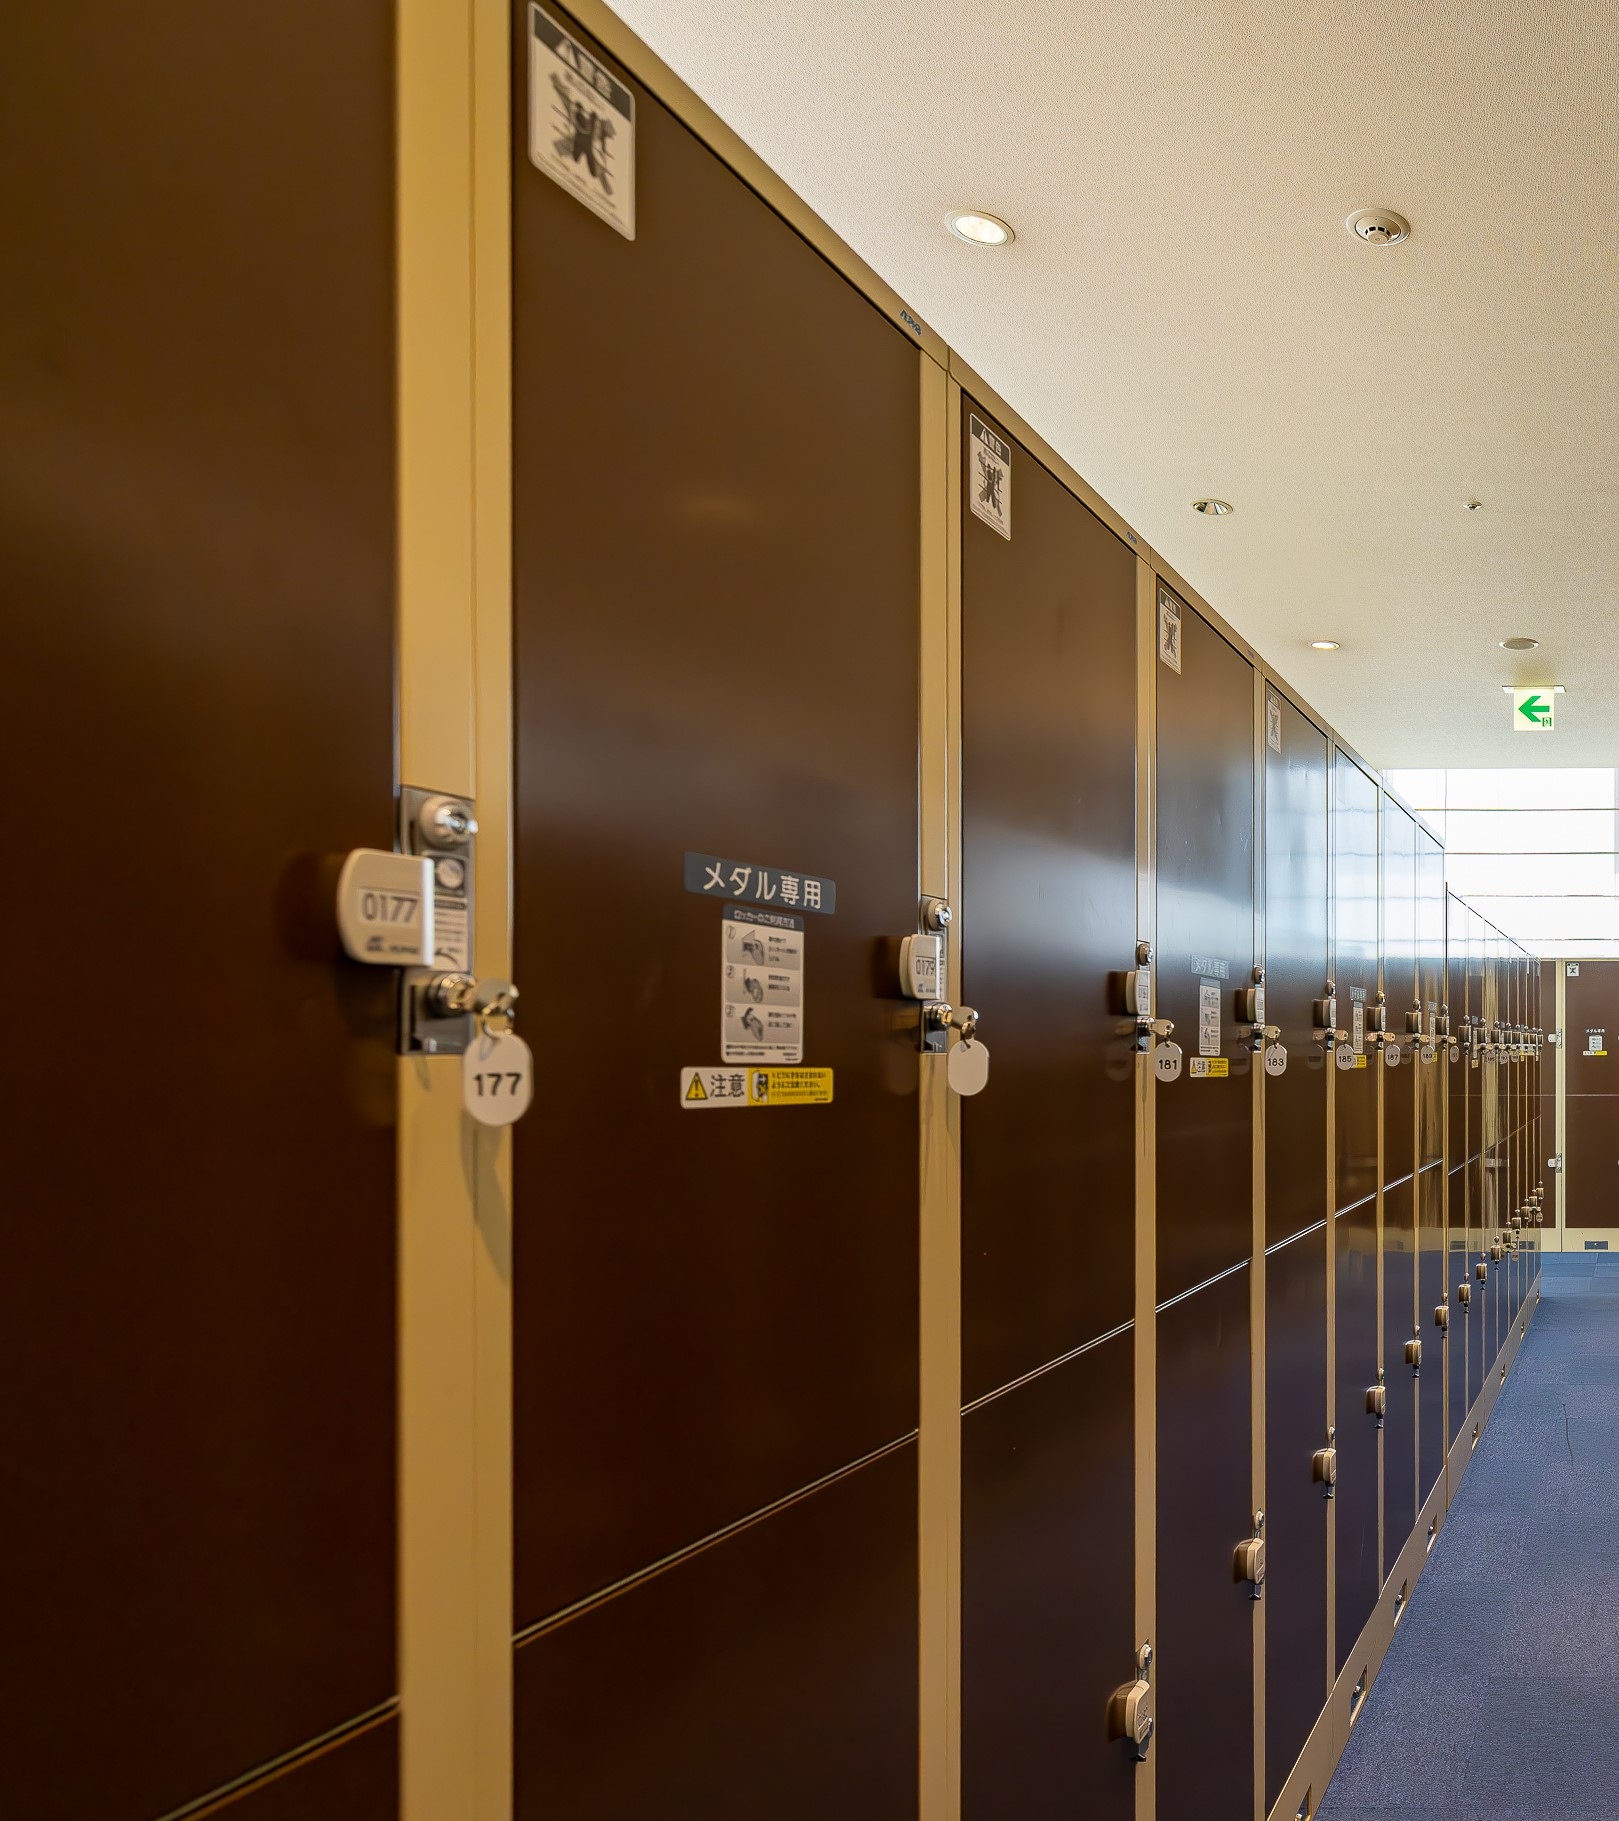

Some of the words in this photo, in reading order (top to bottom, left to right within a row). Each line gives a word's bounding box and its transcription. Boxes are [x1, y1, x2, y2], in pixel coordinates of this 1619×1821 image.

[702, 861, 822, 910] メダル専用
[362, 892, 418, 924] 0177
[916, 959, 934, 976] 0179
[1158, 1059, 1178, 1071] 181
[1267, 1058, 1284, 1068] 183
[1338, 1056, 1353, 1064] 185
[472, 1071, 522, 1096] 177
[710, 1072, 746, 1098] 注意
